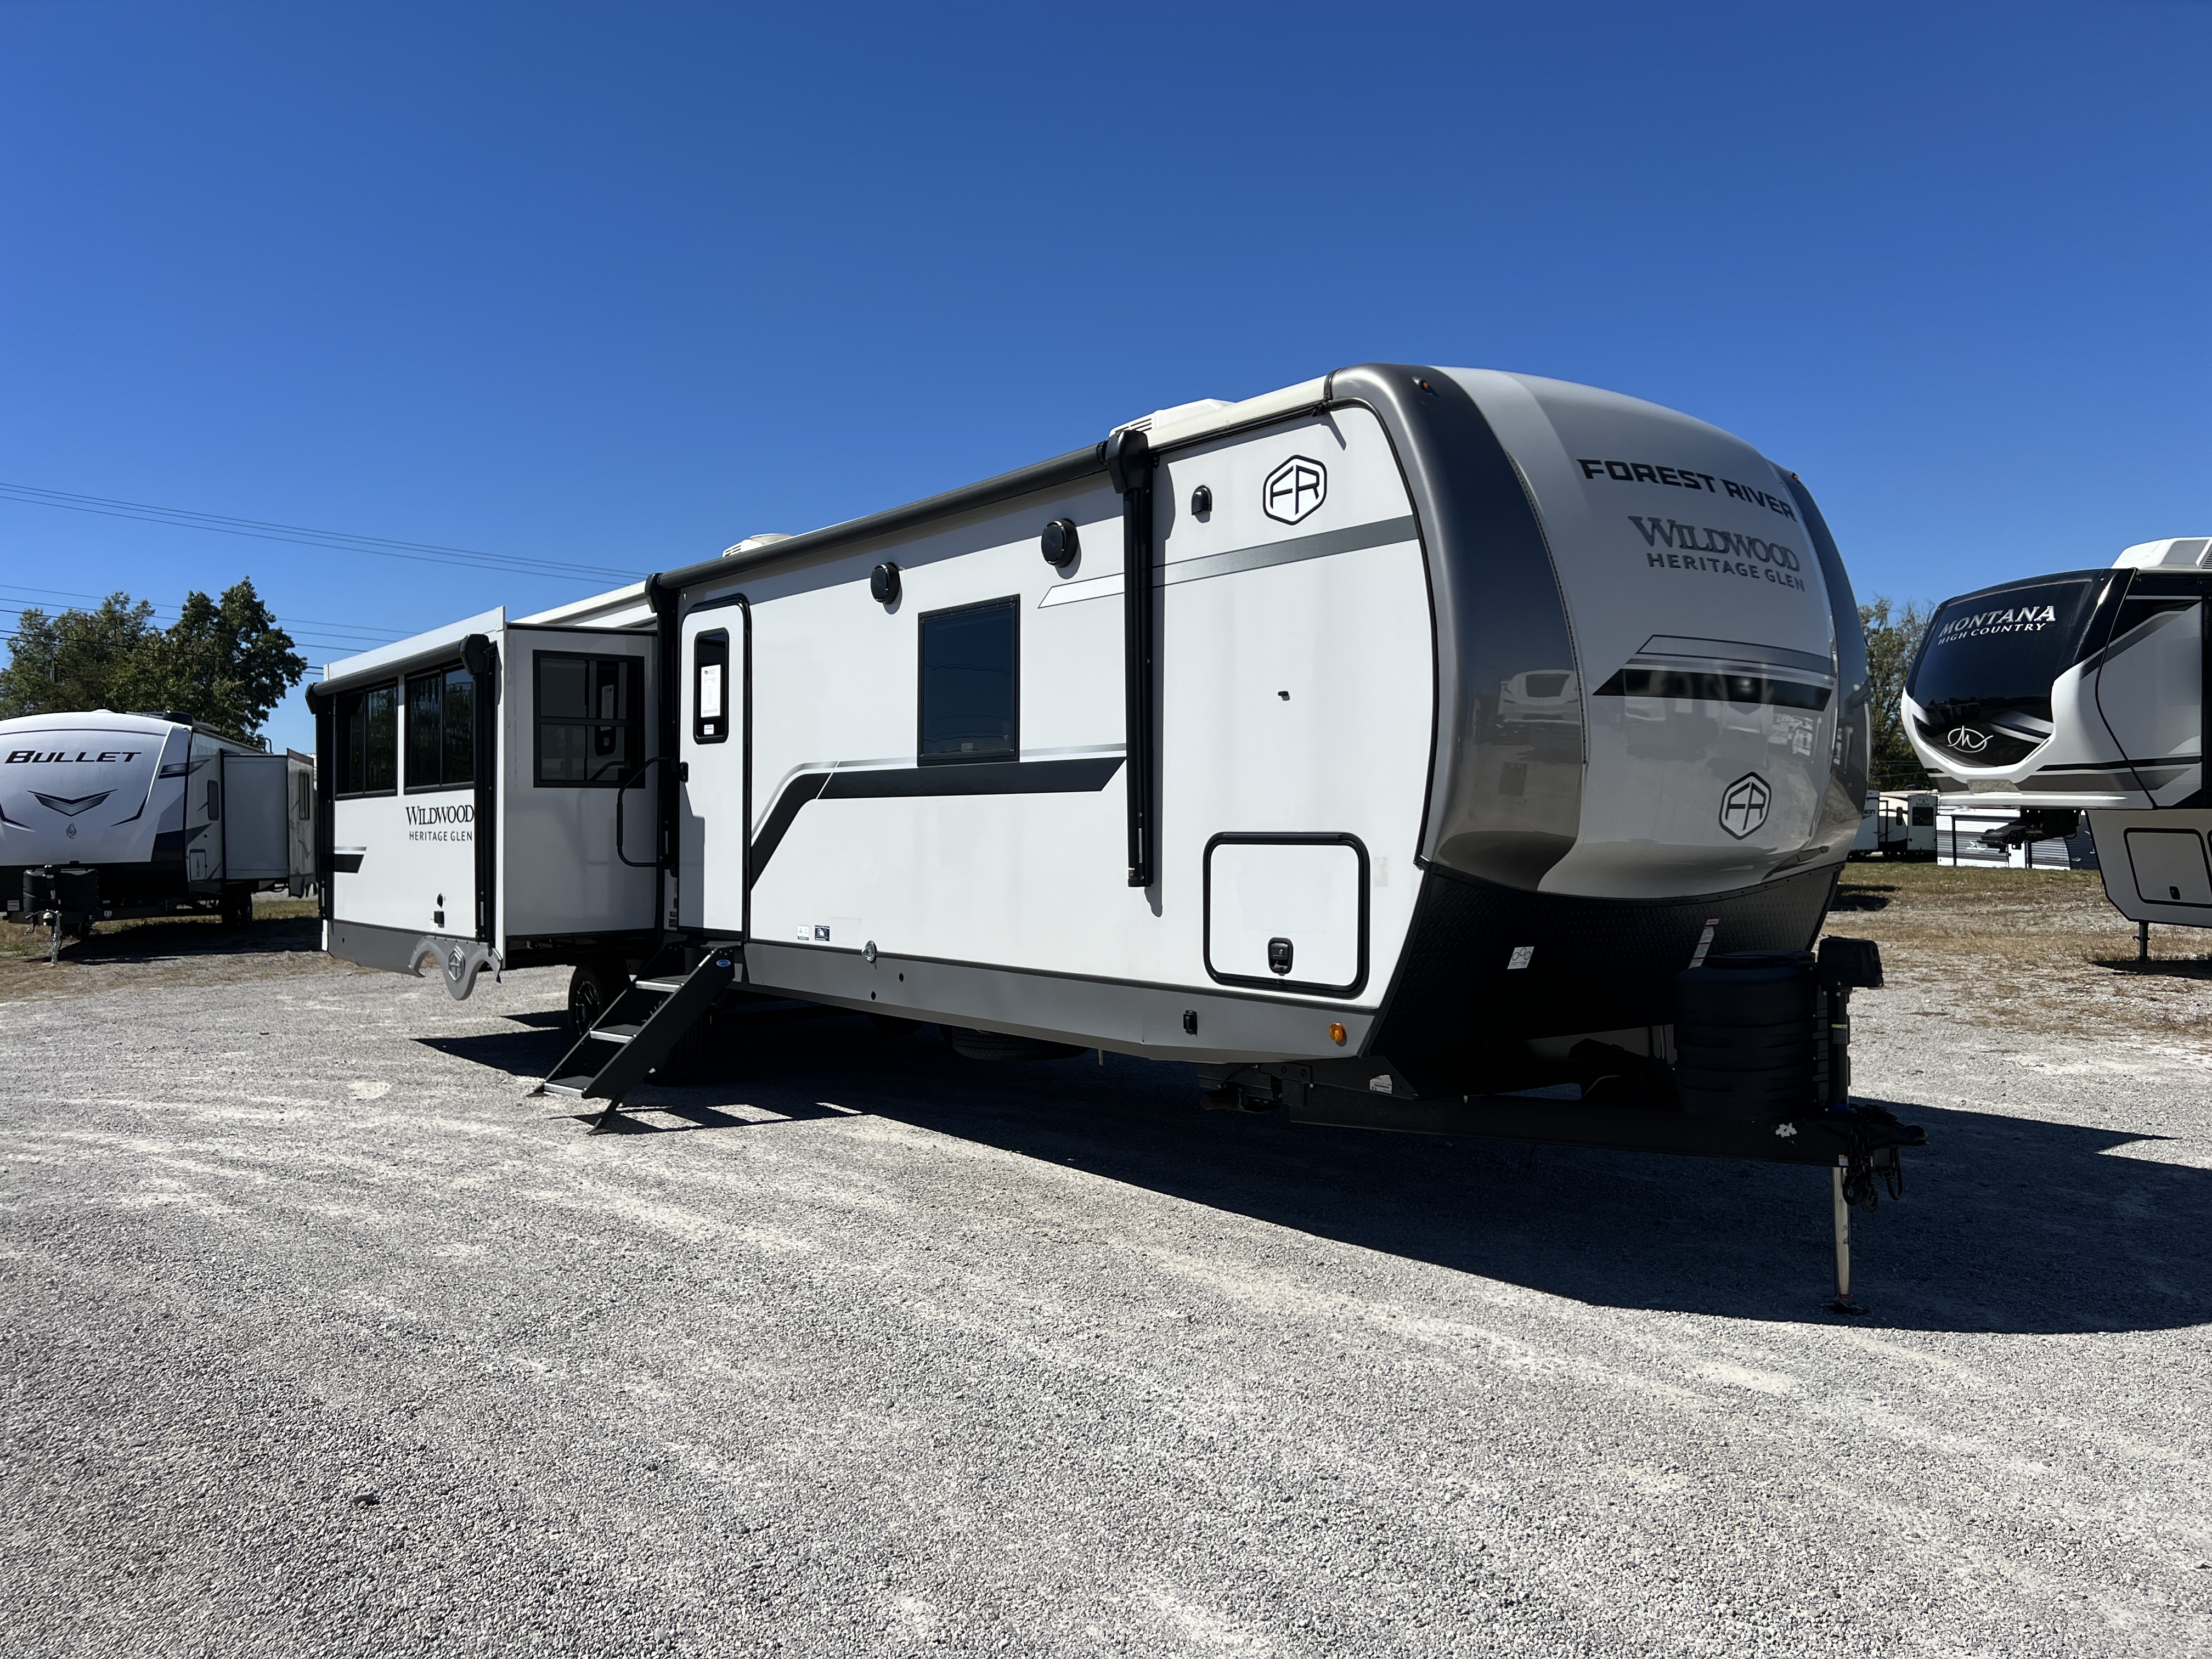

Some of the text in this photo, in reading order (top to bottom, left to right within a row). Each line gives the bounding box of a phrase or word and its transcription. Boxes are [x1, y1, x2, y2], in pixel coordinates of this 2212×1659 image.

[1576, 459, 1798, 522] FOREST RIVER
[1628, 516, 1800, 572] WILDWOOD
[1646, 552, 1805, 592] HERITAGE GLEN
[1938, 605, 2056, 639] MONTANA
[1938, 623, 2046, 646] HIGH COUNTRY
[4, 751, 142, 764] BULLET
[405, 805, 474, 826] WILDWOOD
[409, 831, 472, 842] HERITAGE GLEN
